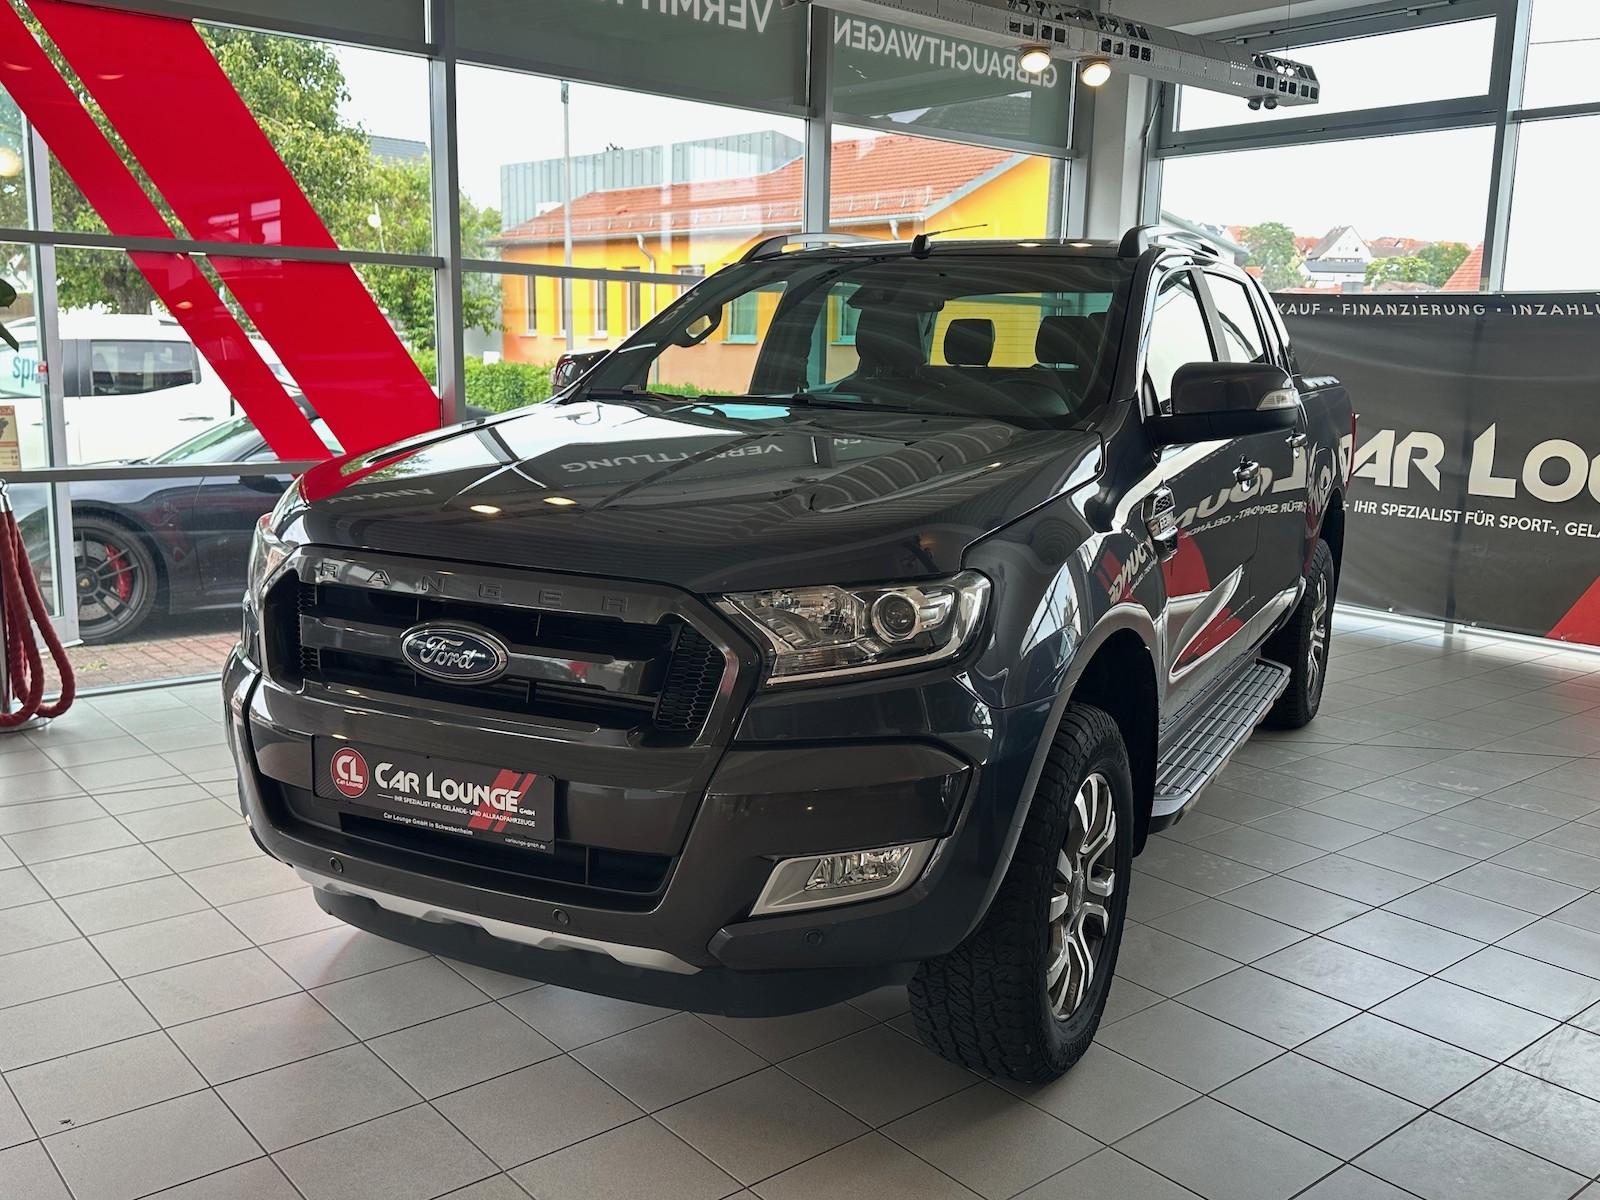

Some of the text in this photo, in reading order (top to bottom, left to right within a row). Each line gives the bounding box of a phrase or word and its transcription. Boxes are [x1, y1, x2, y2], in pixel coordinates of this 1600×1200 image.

[1342, 303, 1487, 316] FINANZIERUNG
[1352, 414, 1600, 503] AR LO
[1353, 500, 1377, 515] IHR
[1380, 502, 1462, 523] SPEZIALIST
[1465, 510, 1495, 528] FÜR
[1498, 515, 1559, 536] SPORT-,
[319, 561, 630, 613] RANGER
[420, 636, 476, 670] Ford
[336, 755, 364, 784] CL
[374, 762, 420, 795] CAR
[426, 771, 522, 813] LOUNGE
[383, 812, 393, 820] Car
[393, 814, 412, 824] Lounge
[412, 818, 428, 826] GmbH
[434, 822, 473, 836] Schwabenheim
[403, 796, 431, 808] SPEZIALIST
[431, 802, 442, 810] FÜR
[482, 812, 536, 827] ALLRADFAHRZEUGE
